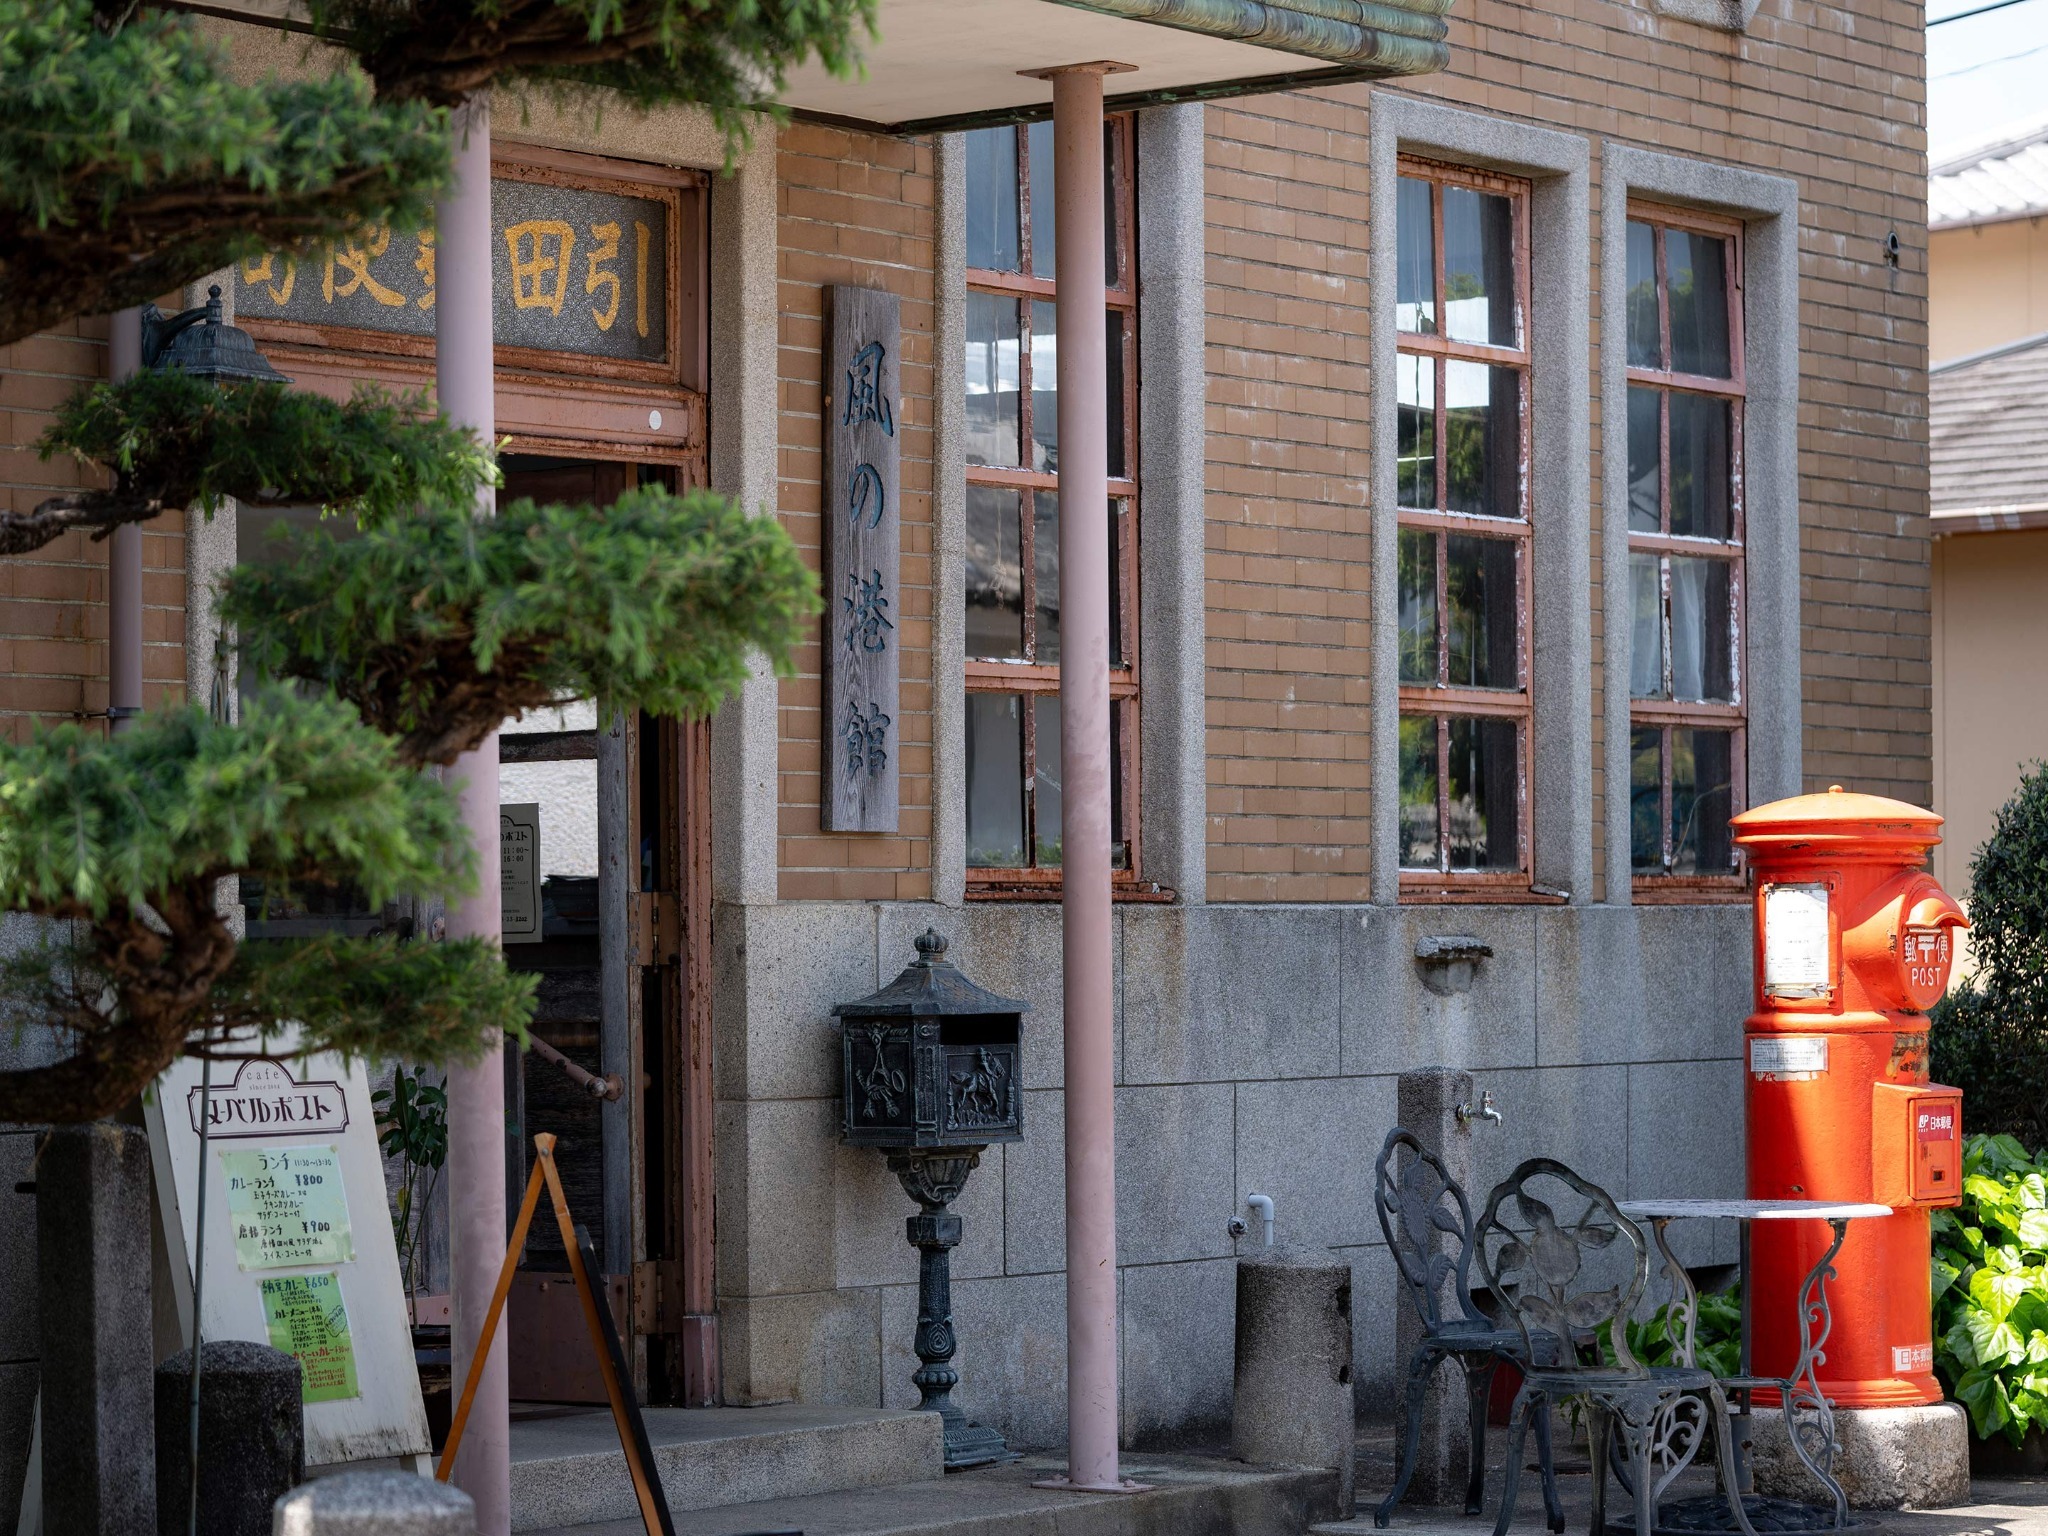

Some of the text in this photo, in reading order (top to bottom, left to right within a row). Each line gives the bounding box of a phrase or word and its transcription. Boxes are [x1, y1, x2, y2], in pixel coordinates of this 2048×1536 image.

[839, 340, 894, 781] 風の港館
[1911, 967, 1941, 987] POST
[246, 1068, 280, 1080] cafe
[1930, 1115, 1952, 1130] 日本郵便
[258, 1153, 290, 1170] ランチ
[231, 1174, 323, 1190] カレーランチ ¥800
[302, 1220, 330, 1233] ¥900
[262, 1279, 302, 1294] 納豆カレー
[304, 1276, 329, 1288] ¥650
